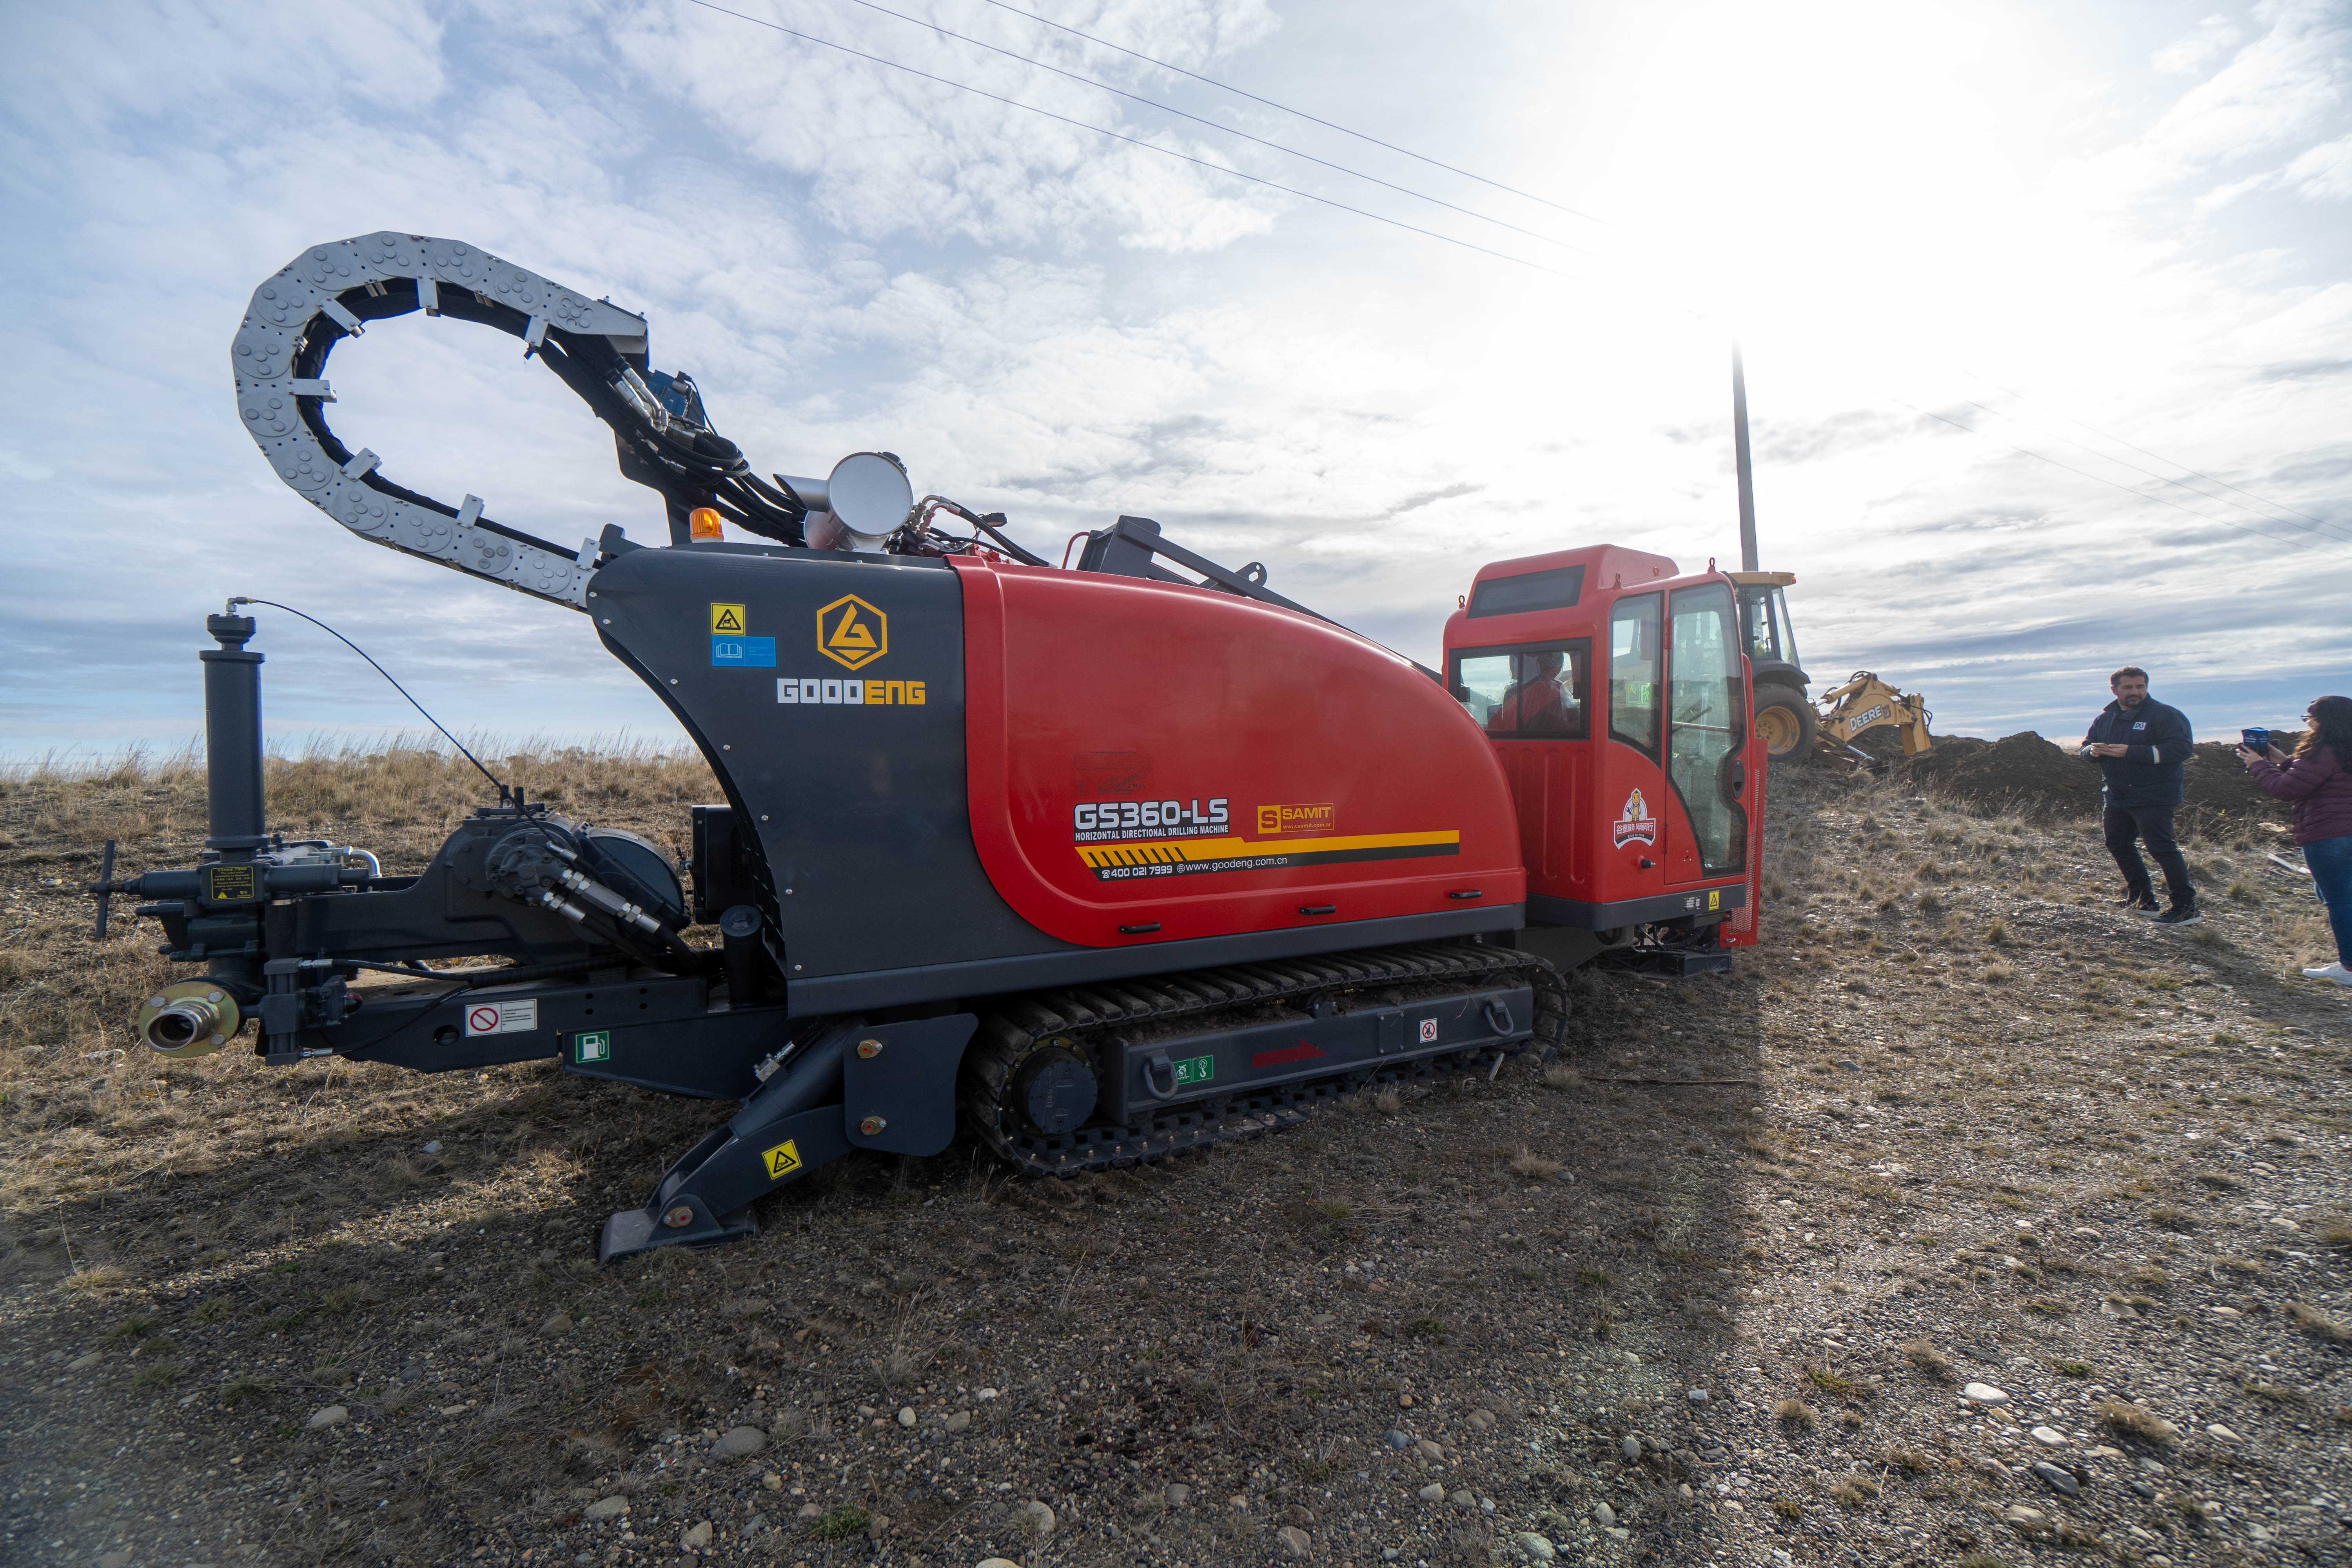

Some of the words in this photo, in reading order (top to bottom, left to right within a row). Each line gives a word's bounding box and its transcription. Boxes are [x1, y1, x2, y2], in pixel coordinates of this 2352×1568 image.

[777, 678, 925, 705] GOODENG
[1849, 705, 1882, 732] DEERE
[1075, 799, 1228, 829] GS360-LS
[1282, 807, 1331, 820] SAMIT
[1075, 831, 1120, 841] HORIZONTAL
[1122, 828, 1166, 838] DIRECTIONAL
[1168, 826, 1198, 836] DRILLING
[1200, 825, 1229, 834] MACHINE
[1111, 868, 1130, 877] 400
[1132, 867, 1147, 876] 021
[1149, 865, 1172, 875] 7999
[1185, 857, 1287, 871] www.goodeng.com.cn
